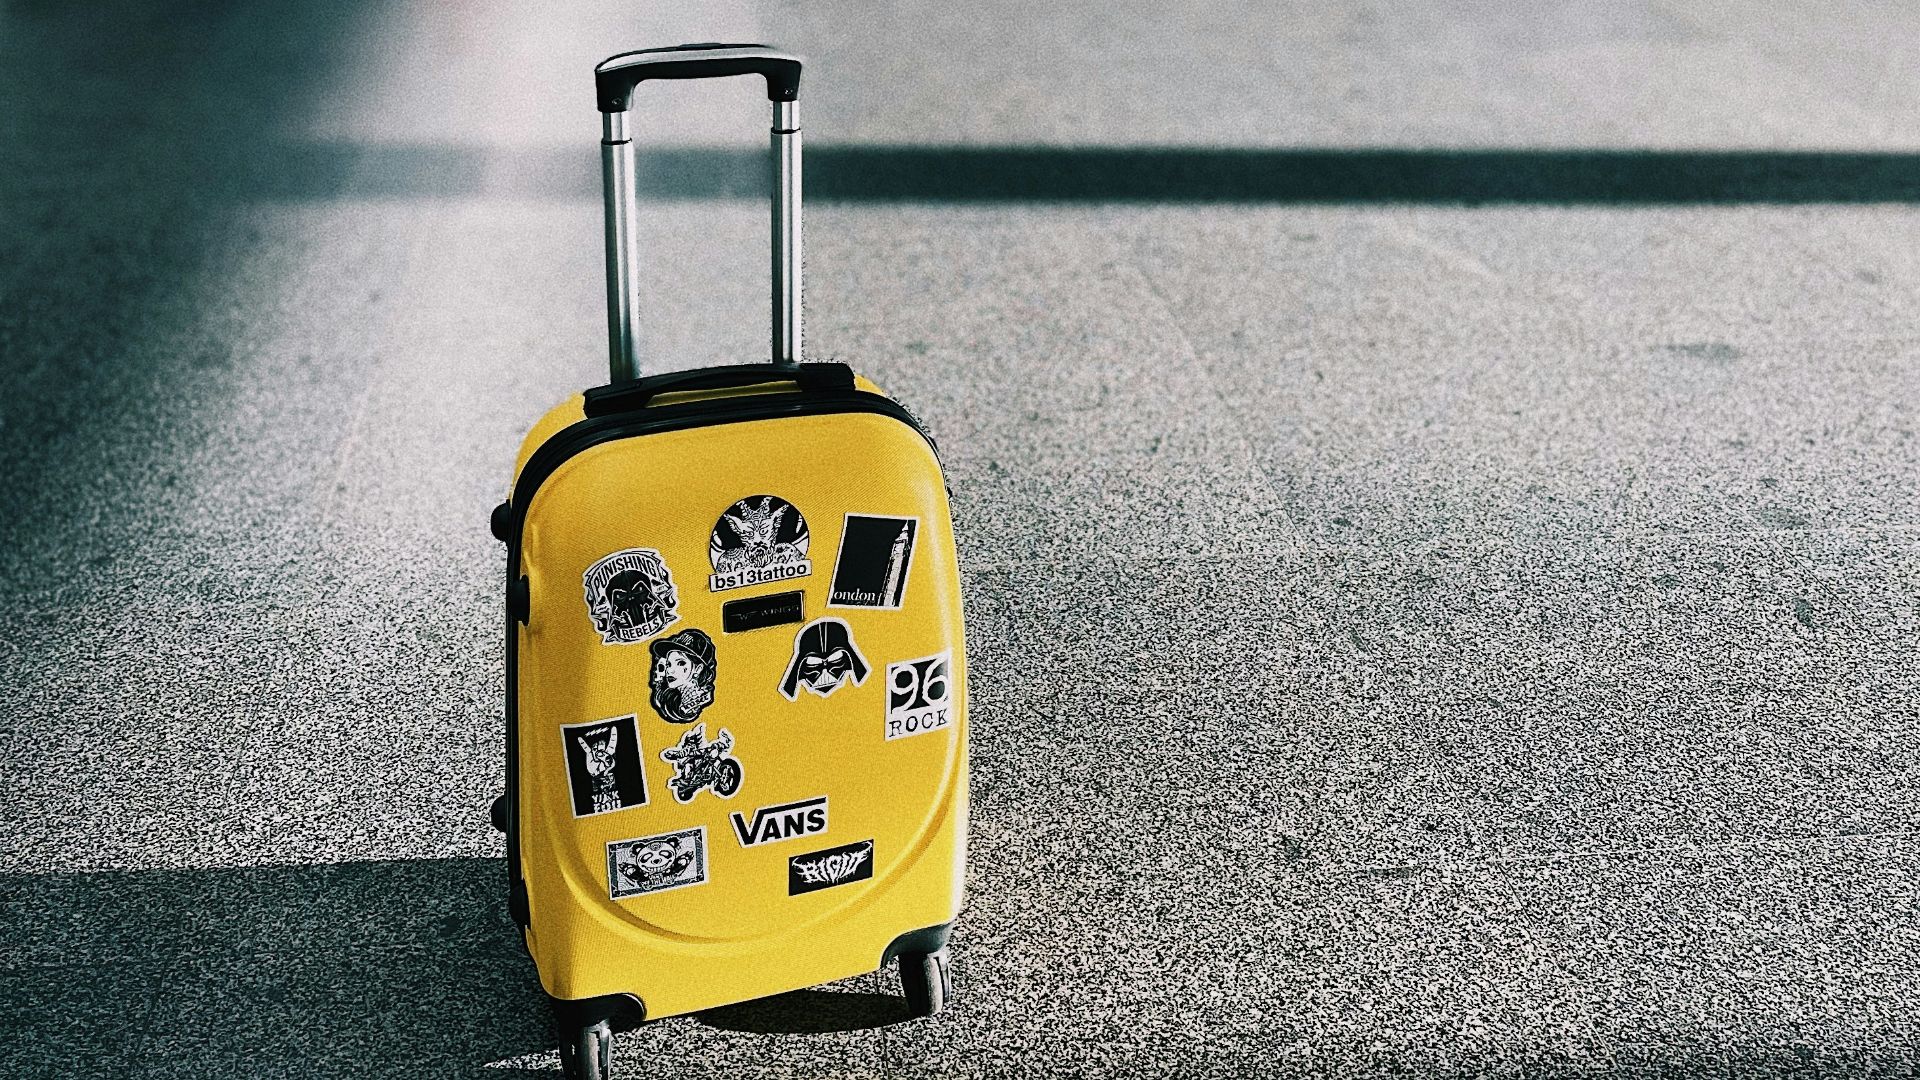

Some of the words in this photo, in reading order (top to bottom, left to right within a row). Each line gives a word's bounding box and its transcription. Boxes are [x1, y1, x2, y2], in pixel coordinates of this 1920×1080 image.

[594, 555, 657, 598] PUNISHING
[715, 564, 807, 589] bs13tattoo
[833, 587, 876, 601] ondon
[622, 618, 661, 639] REBELS
[890, 656, 949, 712] 96
[889, 708, 947, 737] ROCK
[733, 797, 827, 845] VANS
